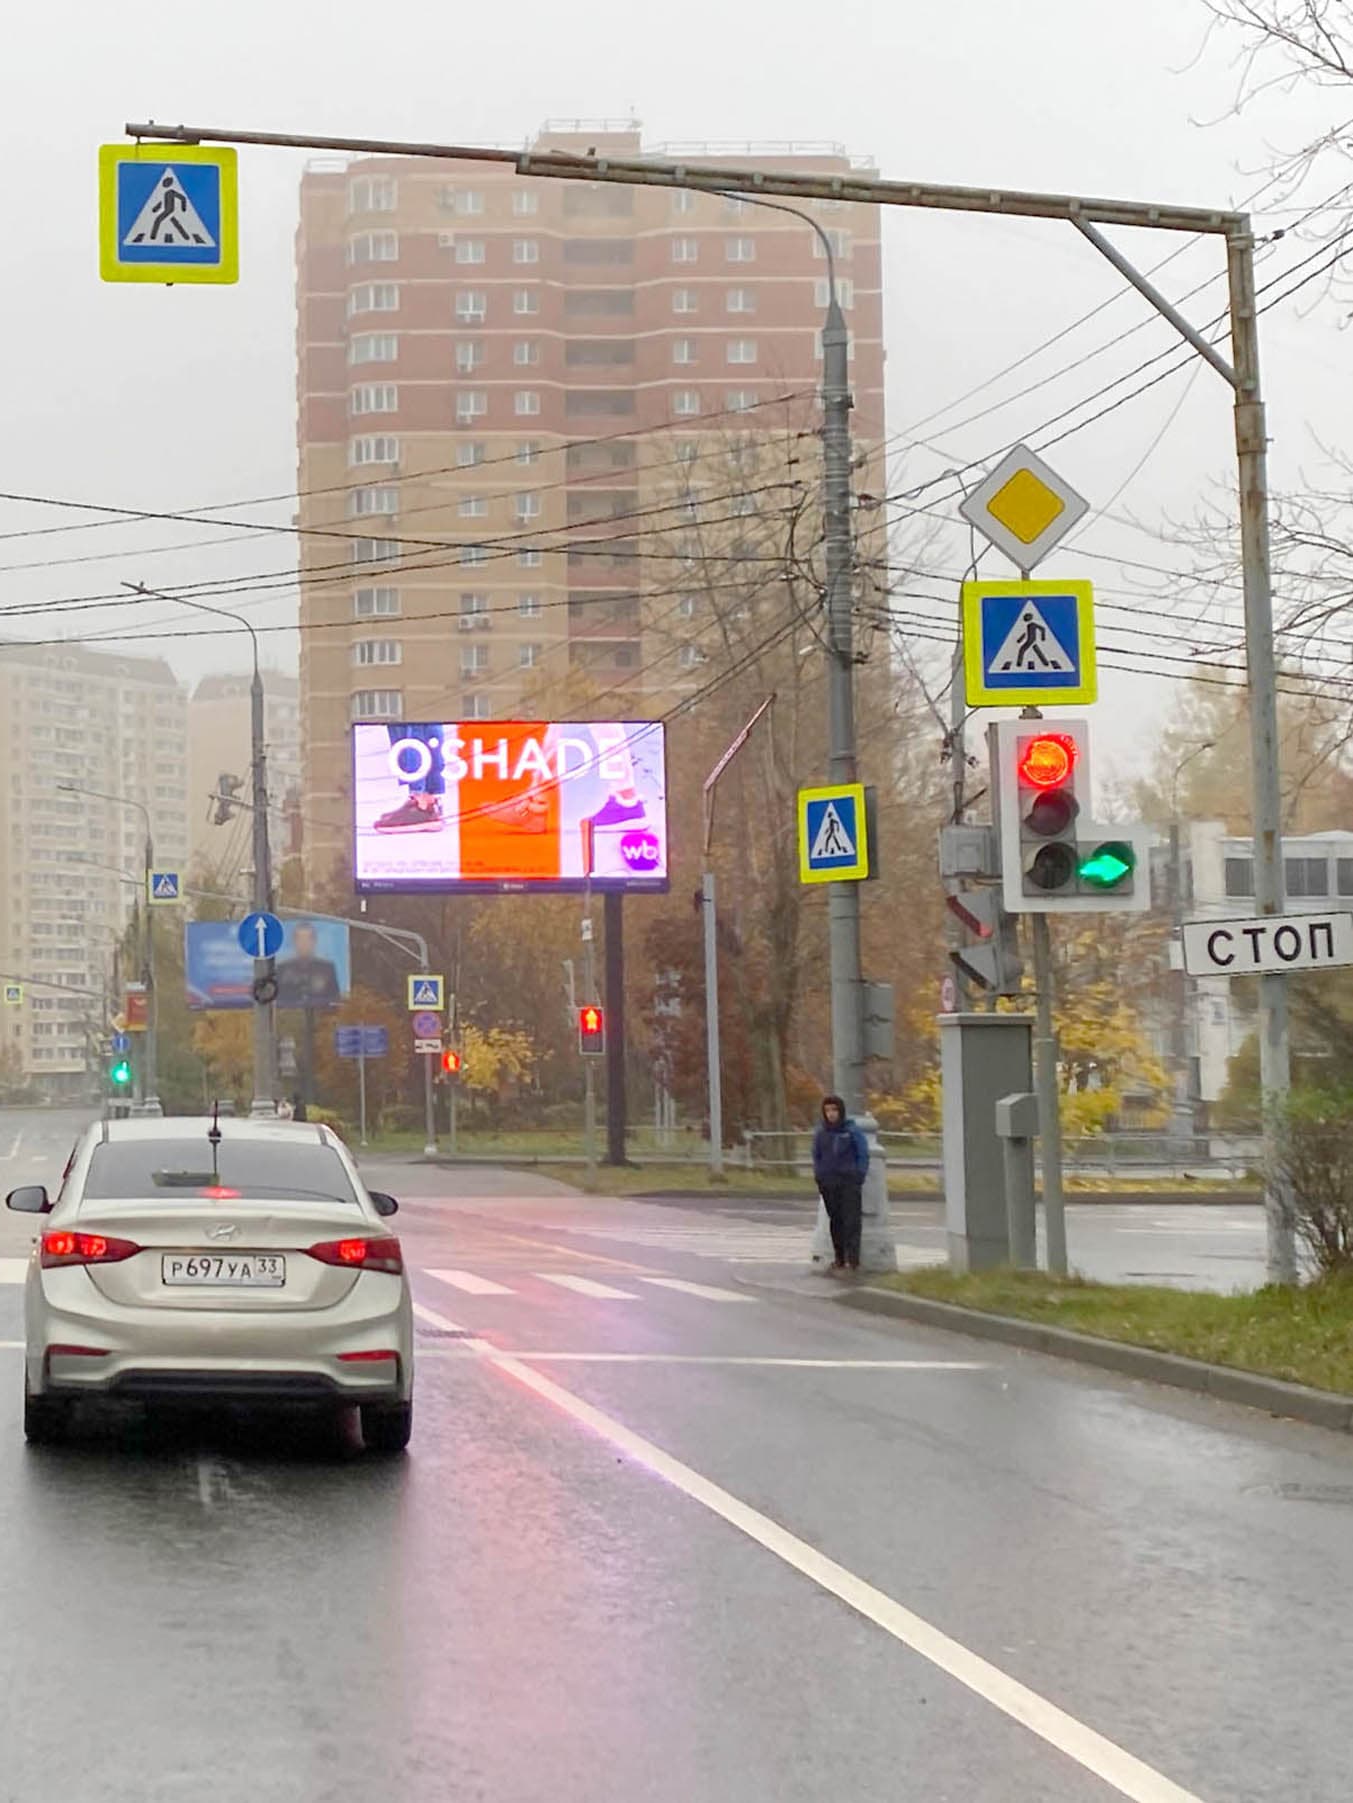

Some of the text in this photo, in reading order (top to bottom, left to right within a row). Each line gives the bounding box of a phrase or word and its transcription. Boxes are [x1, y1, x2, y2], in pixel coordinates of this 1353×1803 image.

[622, 840, 658, 861] wb
[1207, 922, 1334, 966] СТОП
[171, 1257, 278, 1279] Р697УА 33
